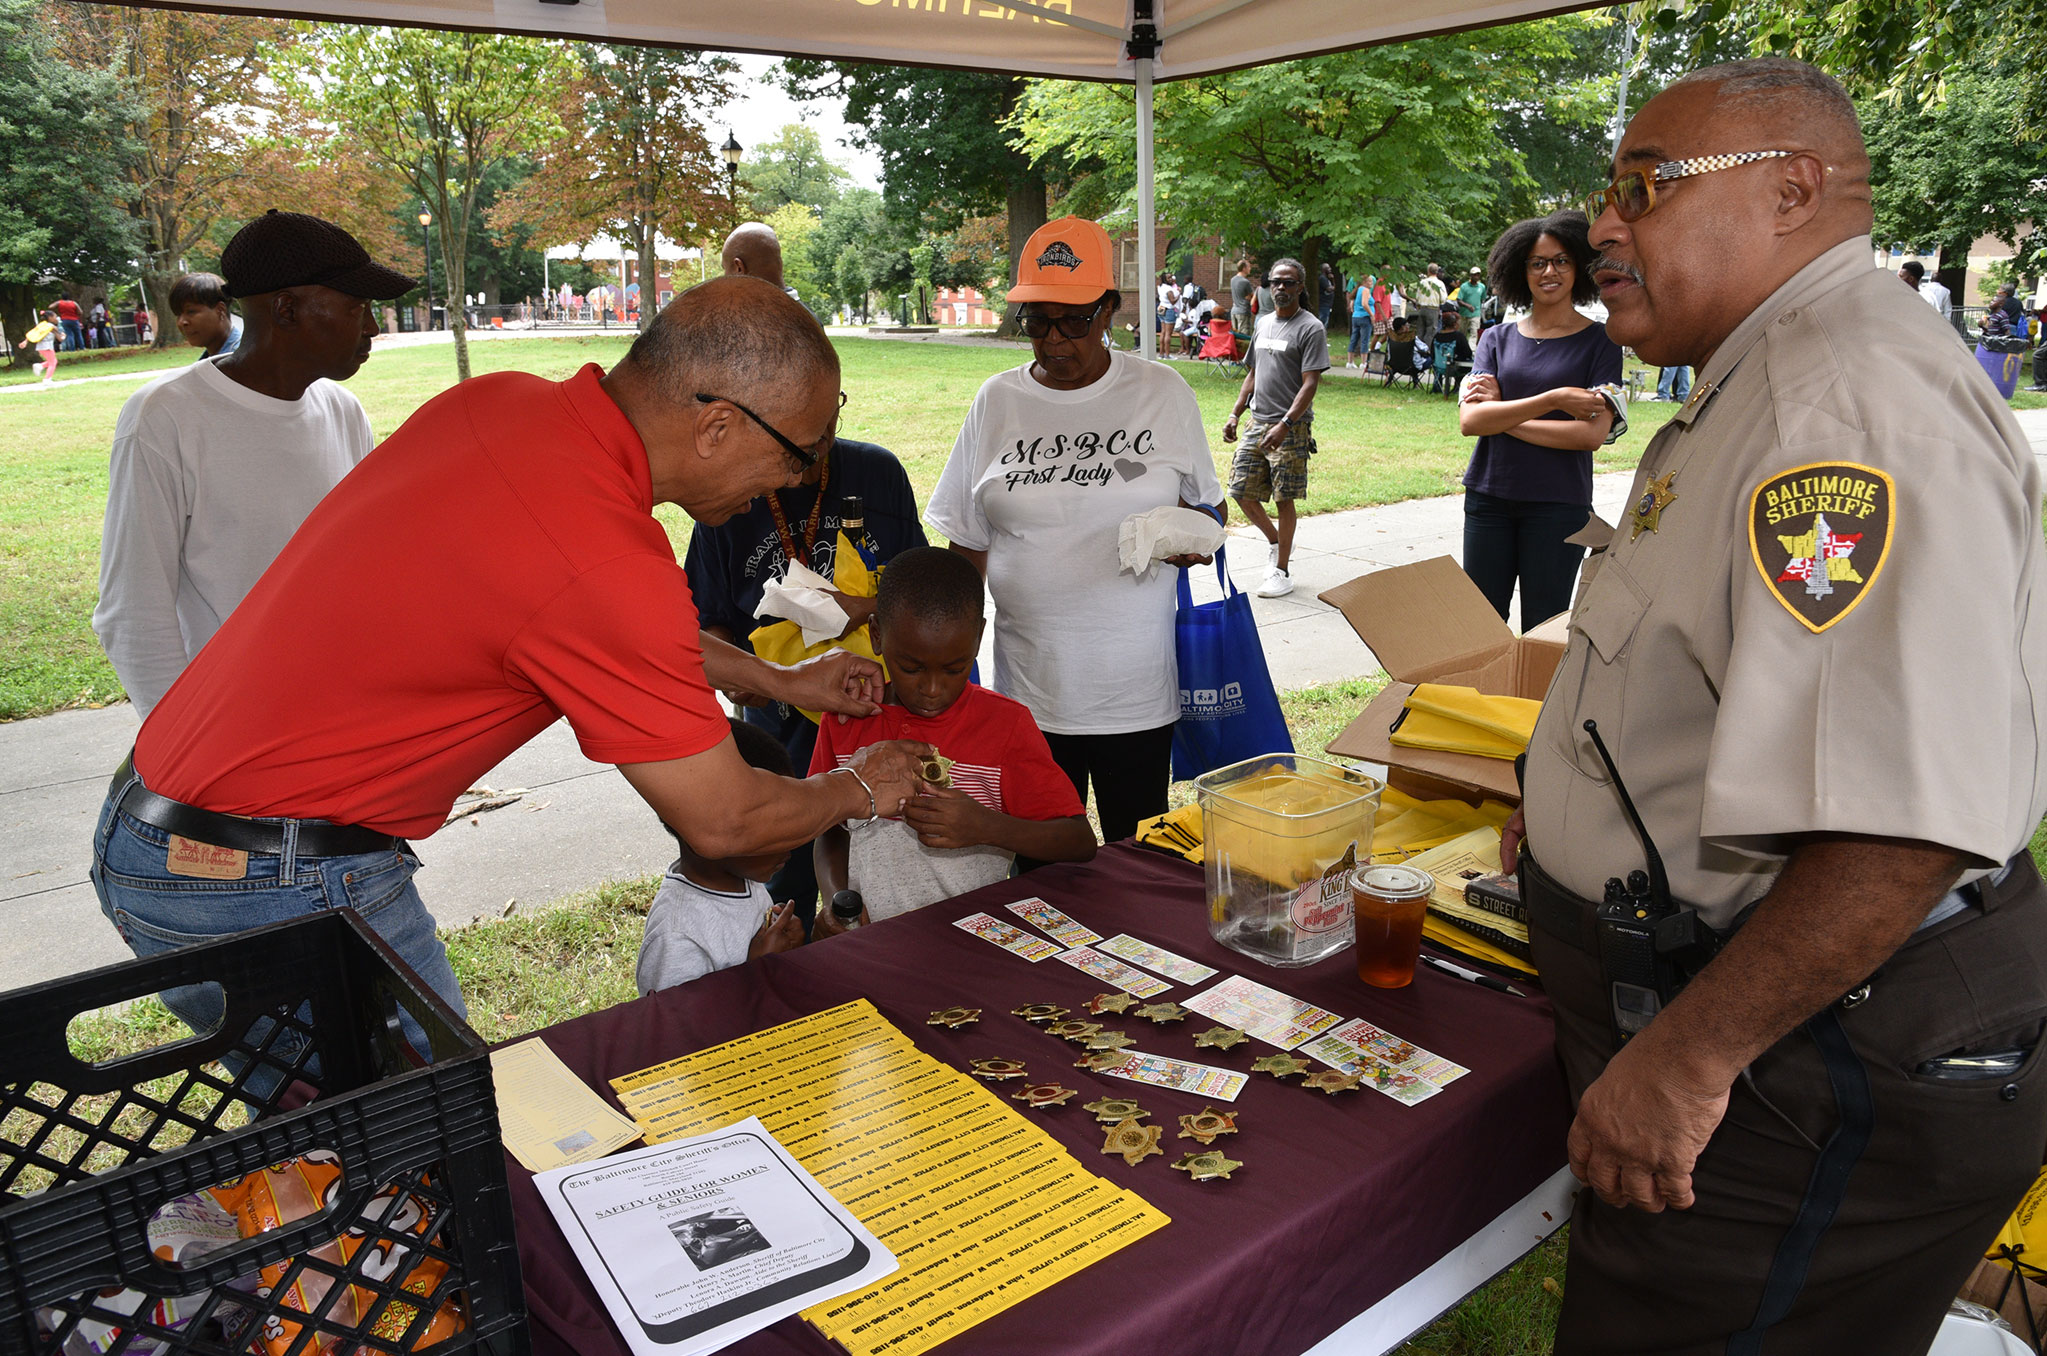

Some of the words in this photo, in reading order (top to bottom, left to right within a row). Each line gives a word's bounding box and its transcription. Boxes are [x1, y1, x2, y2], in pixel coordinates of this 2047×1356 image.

[1005, 465, 1063, 492] First
[1061, 462, 1114, 487] Lady
[1765, 476, 1879, 507] BALTIMORE
[1766, 495, 1876, 525] SHERIFF
[1224, 698, 1244, 708] CITY
[1319, 878, 1343, 903] KING
[1483, 895, 1516, 918] STREET
[1064, 934, 1099, 946] KIDS
[1616, 927, 1649, 936] MOTOROLA
[1025, 945, 1060, 960] KIDS
[807, 1013, 824, 1021] CITY
[823, 1002, 858, 1015] BALTIMORE
[776, 1019, 808, 1031] SHERIFF'S
[1305, 1014, 1341, 1032] KIDS
[735, 1037, 752, 1045] John
[754, 1029, 777, 1038] OFFICE
[692, 1046, 726, 1059] Anderson,
[667, 1057, 692, 1067] Sheriff
[1428, 1065, 1465, 1085] KIDS
[1216, 1075, 1242, 1098] KIDS
[567, 1178, 591, 1189] The
[591, 1163, 649, 1182] Baltimore
[648, 1157, 674, 1168] City
[672, 1145, 721, 1161] Sheriff's
[719, 1137, 753, 1148] Office
[593, 1198, 648, 1218] SAFETY
[646, 1186, 691, 1202] GUIDE
[689, 1178, 718, 1190] FOR
[716, 1164, 771, 1182] WOMEN
[667, 1186, 725, 1205] SENIORS
[1059, 1184, 1100, 1205] BALTIMORE
[664, 1207, 689, 1217] Public
[689, 1201, 714, 1211] Safety
[712, 1195, 735, 1204] Guide
[1041, 1202, 1062, 1214] CITY
[1084, 1196, 1125, 1217] BALTIMORE
[1006, 1211, 1043, 1231] SHERIFF'S
[1066, 1215, 1087, 1226] CITY
[1105, 1211, 1146, 1234] BALTIMORE
[981, 1228, 1009, 1243] OFFICE
[1031, 1224, 1069, 1244] SHERIFF'S
[1087, 1231, 1108, 1243] CITY
[960, 1242, 980, 1254] John
[1006, 1241, 1034, 1257] OFFICE
[1051, 1240, 1089, 1261] SHERIFF'S
[653, 1283, 691, 1298] Honorable
[690, 1276, 708, 1285] John
[752, 1253, 775, 1263] Sheriff
[782, 1241, 812, 1253] Baltimore
[696, 1279, 718, 1289] Henry
[753, 1260, 772, 1269] Chief
[771, 1252, 795, 1263] Deputy
[909, 1256, 950, 1278] Anderson,
[985, 1256, 1005, 1268] John
[1025, 1258, 1054, 1274] OFFICE
[683, 1294, 715, 1307] Theodore
[715, 1283, 743, 1295] Haskins
[755, 1266, 792, 1281] Community
[791, 1255, 821, 1268] Relations
[689, 1287, 715, 1298] Lenora
[785, 1253, 809, 1264] Sheriff
[880, 1275, 910, 1292] Sheriff
[934, 1271, 975, 1293] Anderson,
[1004, 1273, 1025, 1286] John
[905, 1290, 935, 1307] Sheriff
[953, 1289, 995, 1312] Anderson,
[924, 1309, 954, 1327] Sheriff
